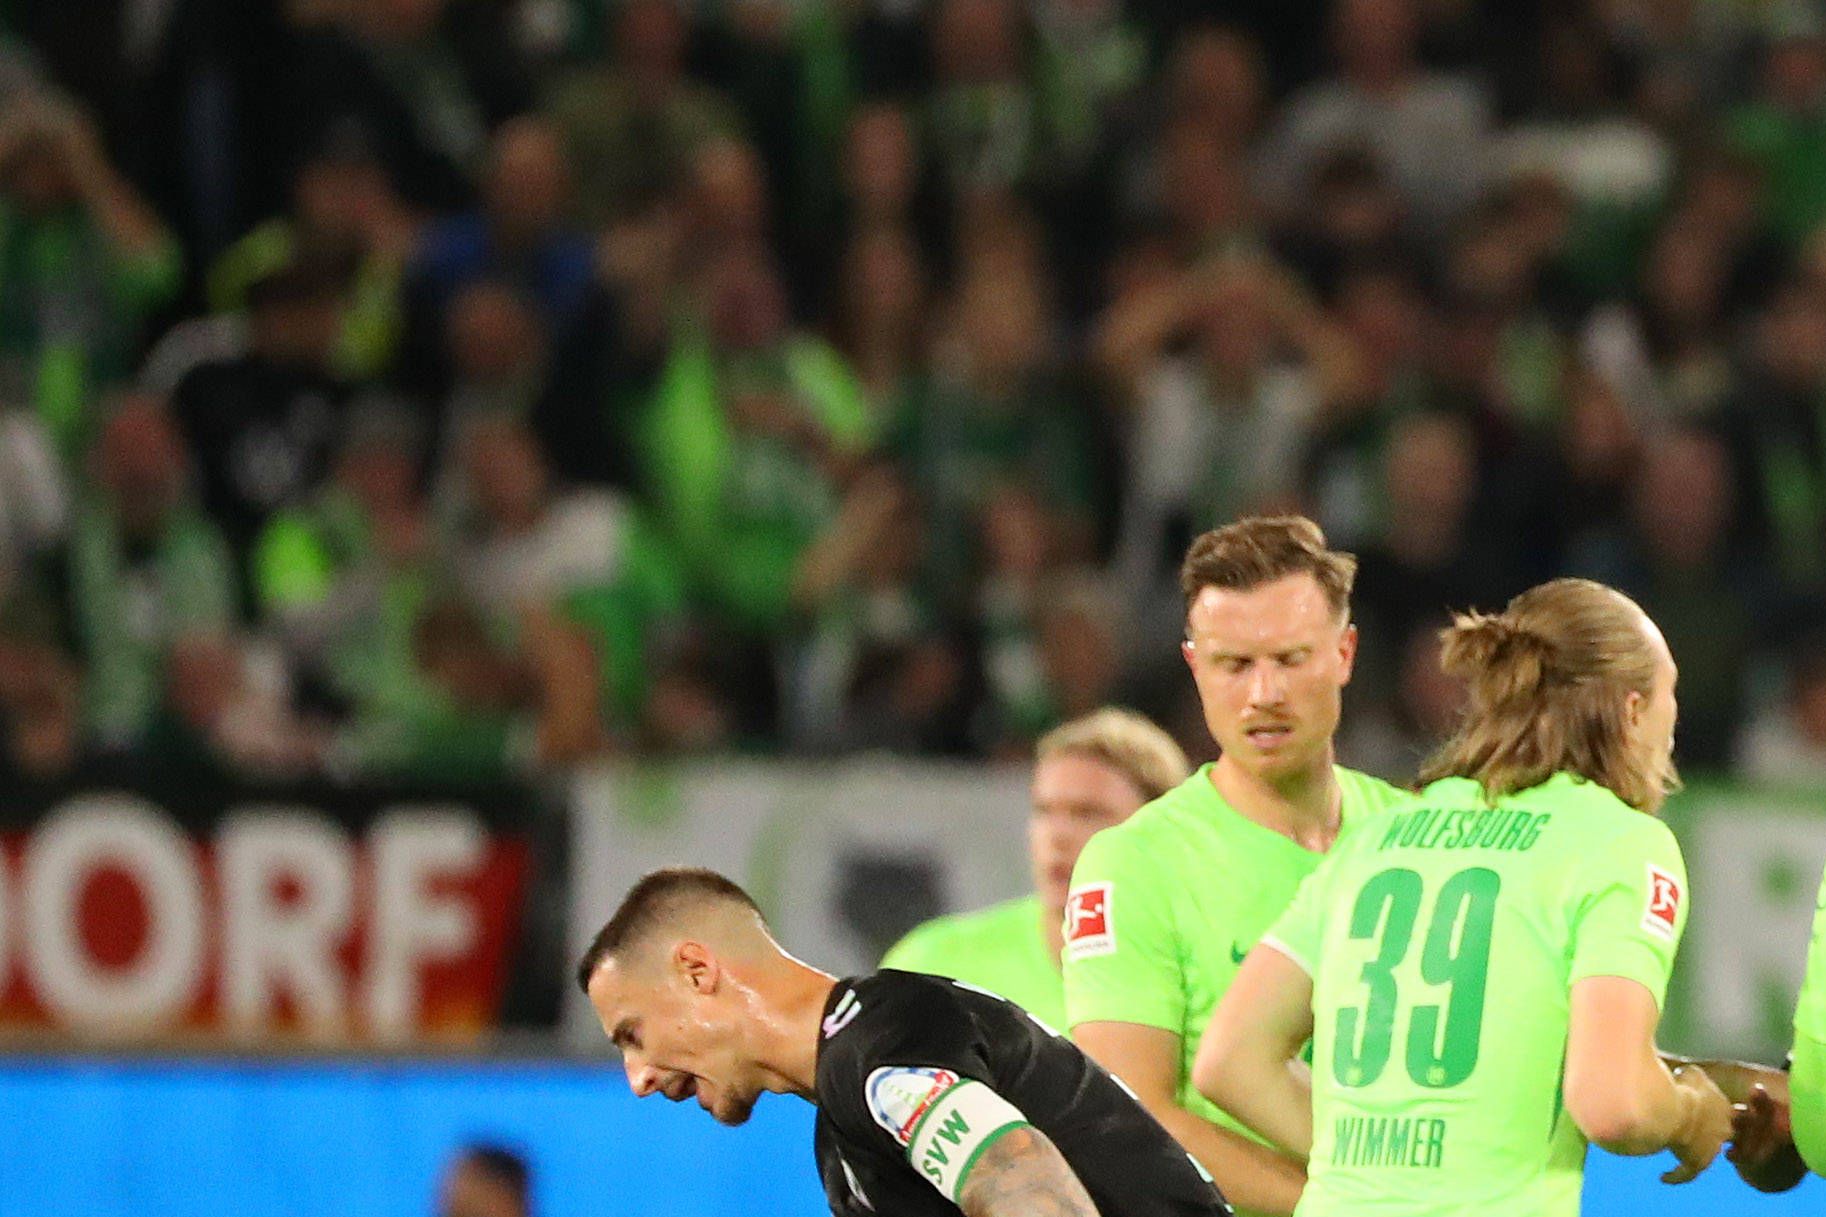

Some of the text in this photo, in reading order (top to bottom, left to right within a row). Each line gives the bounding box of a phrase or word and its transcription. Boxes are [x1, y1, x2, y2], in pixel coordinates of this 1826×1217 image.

[1378, 809, 1552, 852] WOLFSBURG
[0, 796, 486, 1042] ORF
[1332, 867, 1501, 1089] 39
[923, 1108, 971, 1186] SVW
[1331, 1117, 1446, 1167] WIMMER
